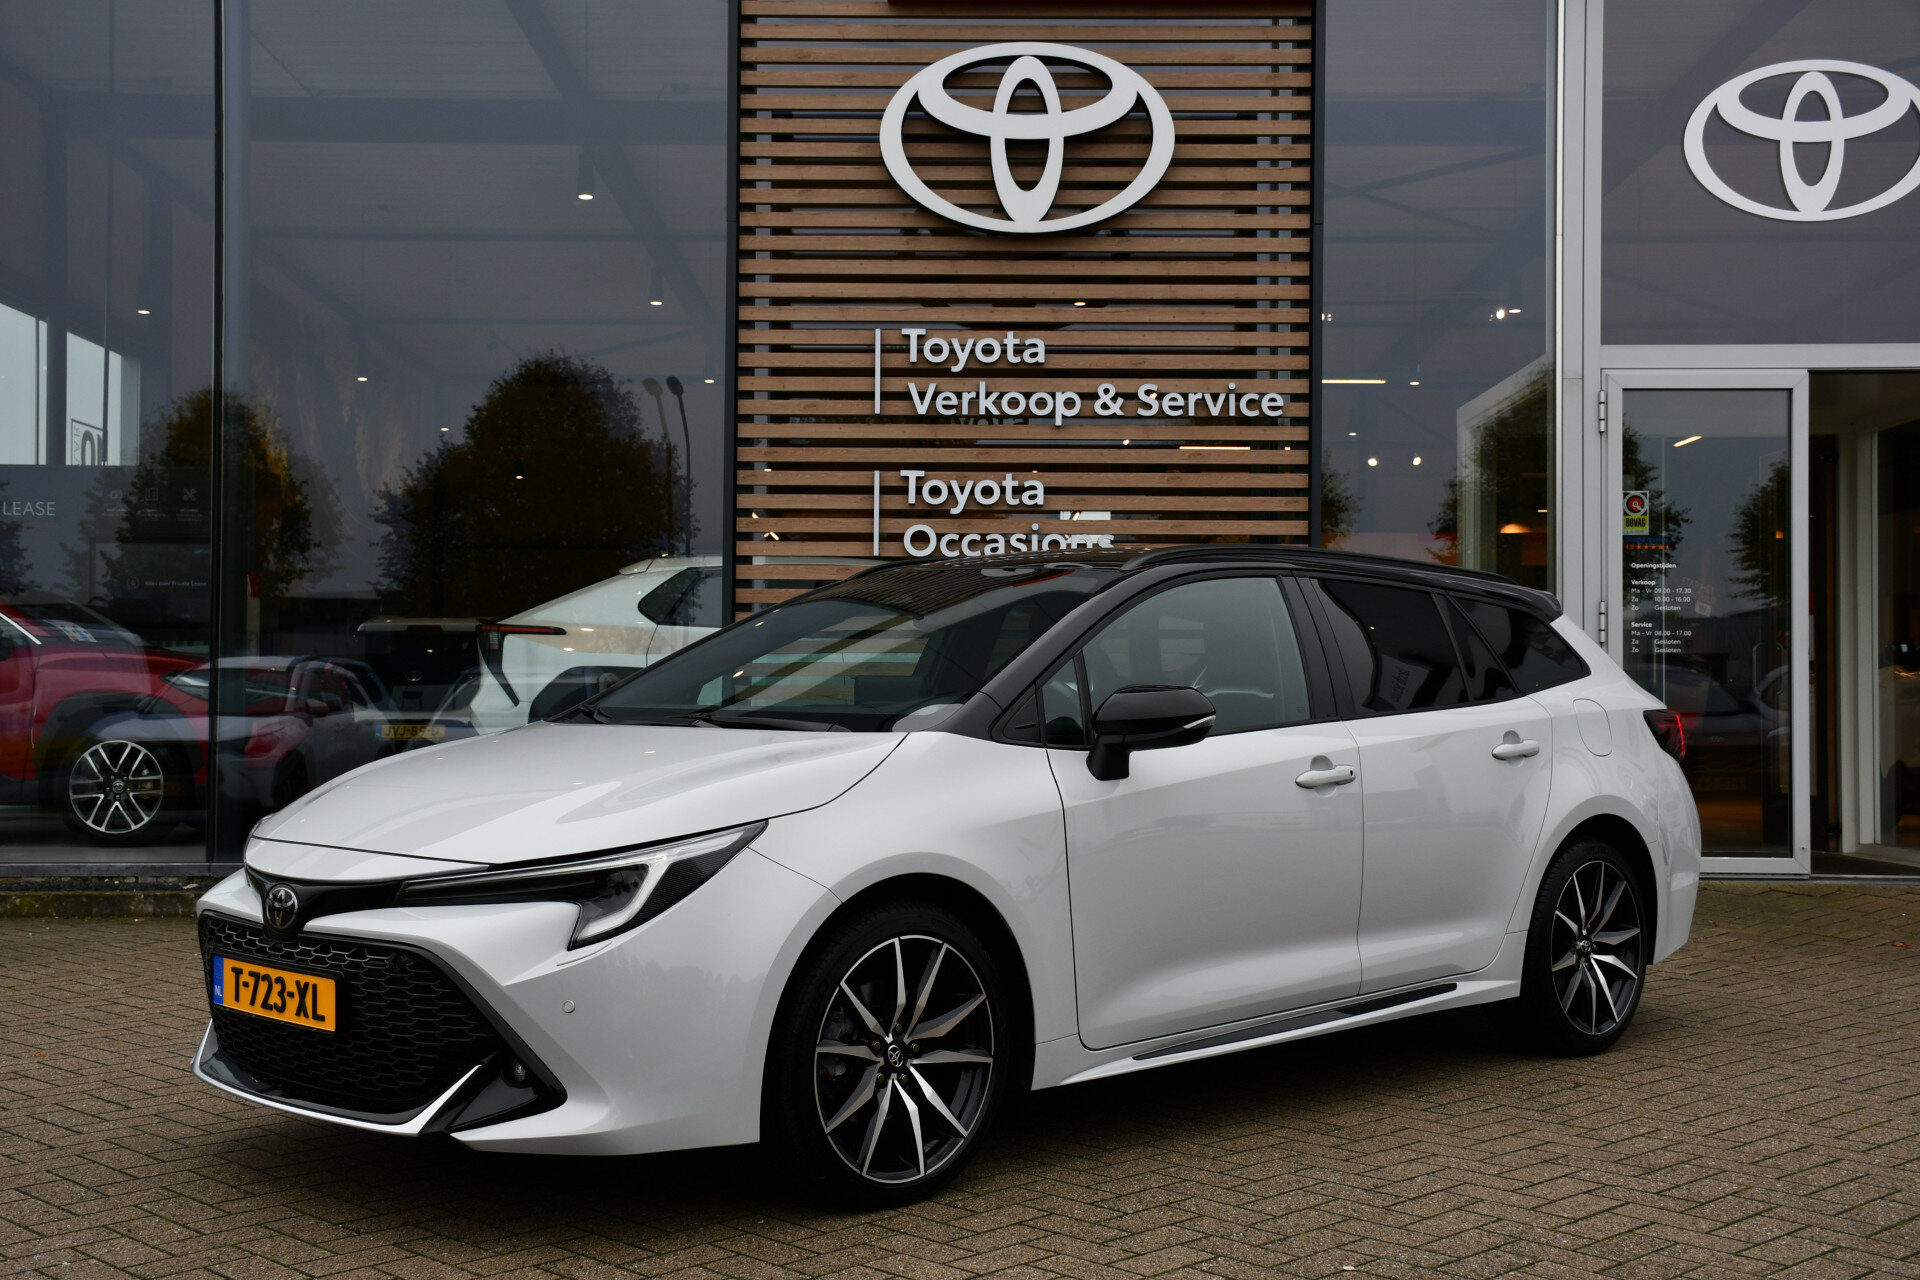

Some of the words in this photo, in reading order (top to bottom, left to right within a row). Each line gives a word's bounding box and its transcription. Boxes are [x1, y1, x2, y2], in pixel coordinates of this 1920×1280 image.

[901, 328, 1046, 373] Toyota
[908, 381, 1082, 426] Verkoop
[1093, 382, 1125, 417] &
[1136, 382, 1284, 417] Service
[3, 501, 56, 516] LEASE
[900, 470, 1045, 514] Toyota
[903, 523, 1115, 558] Occasions
[1625, 518, 1646, 527] BOVAG
[231, 967, 326, 1022] T-723-XL
